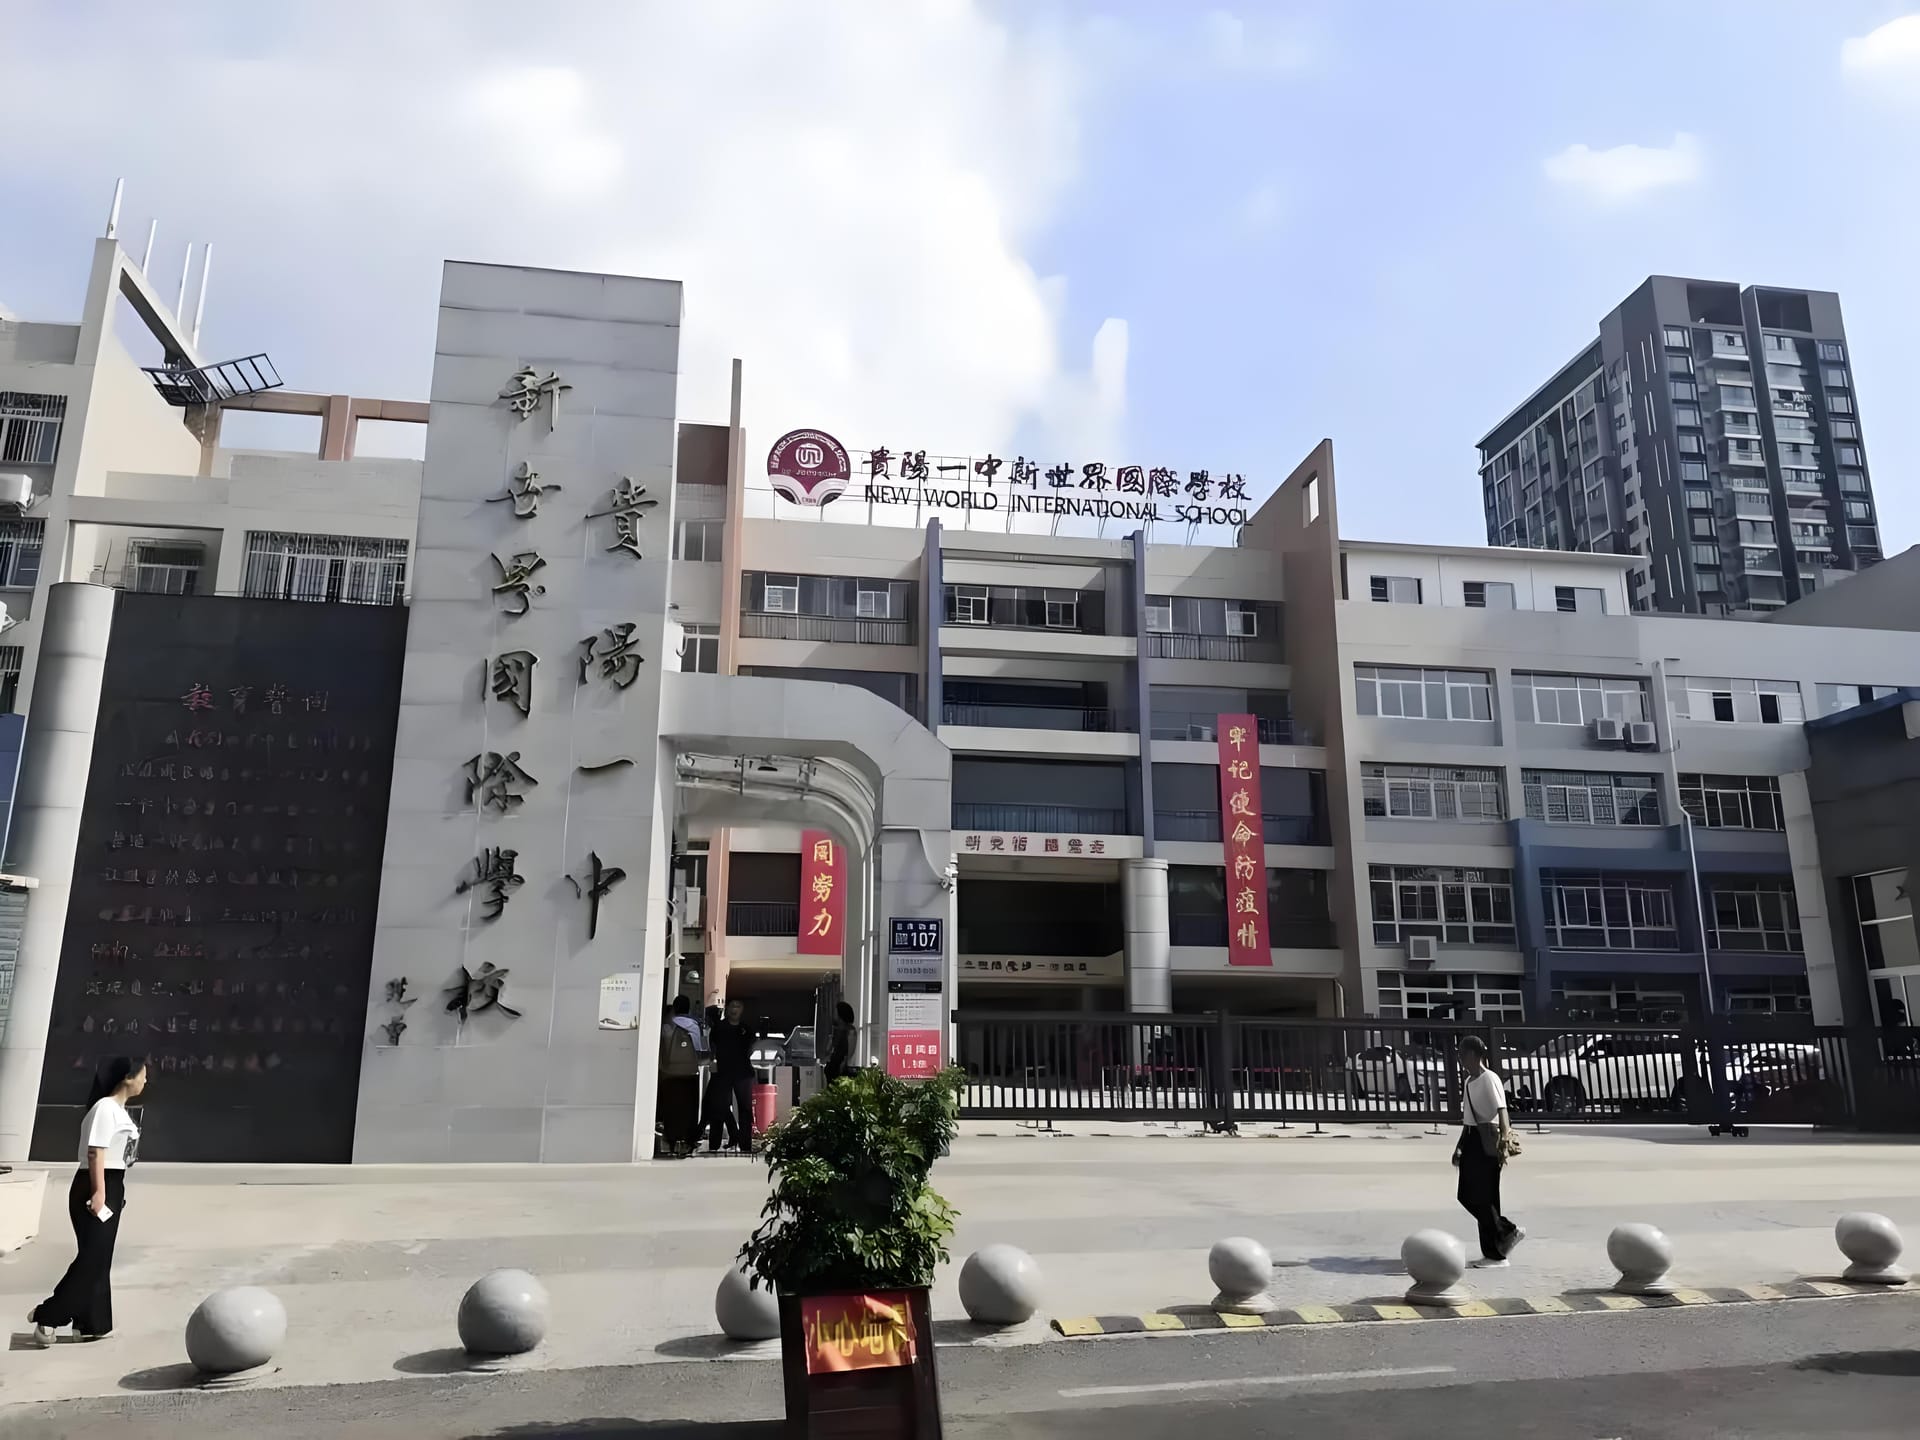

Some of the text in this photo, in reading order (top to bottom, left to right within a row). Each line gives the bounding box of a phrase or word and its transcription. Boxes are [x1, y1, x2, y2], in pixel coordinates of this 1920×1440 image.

[866, 485, 1254, 526] NEW WORLD INTERNATIONAL SCHOOL
[910, 932, 937, 947] 107
